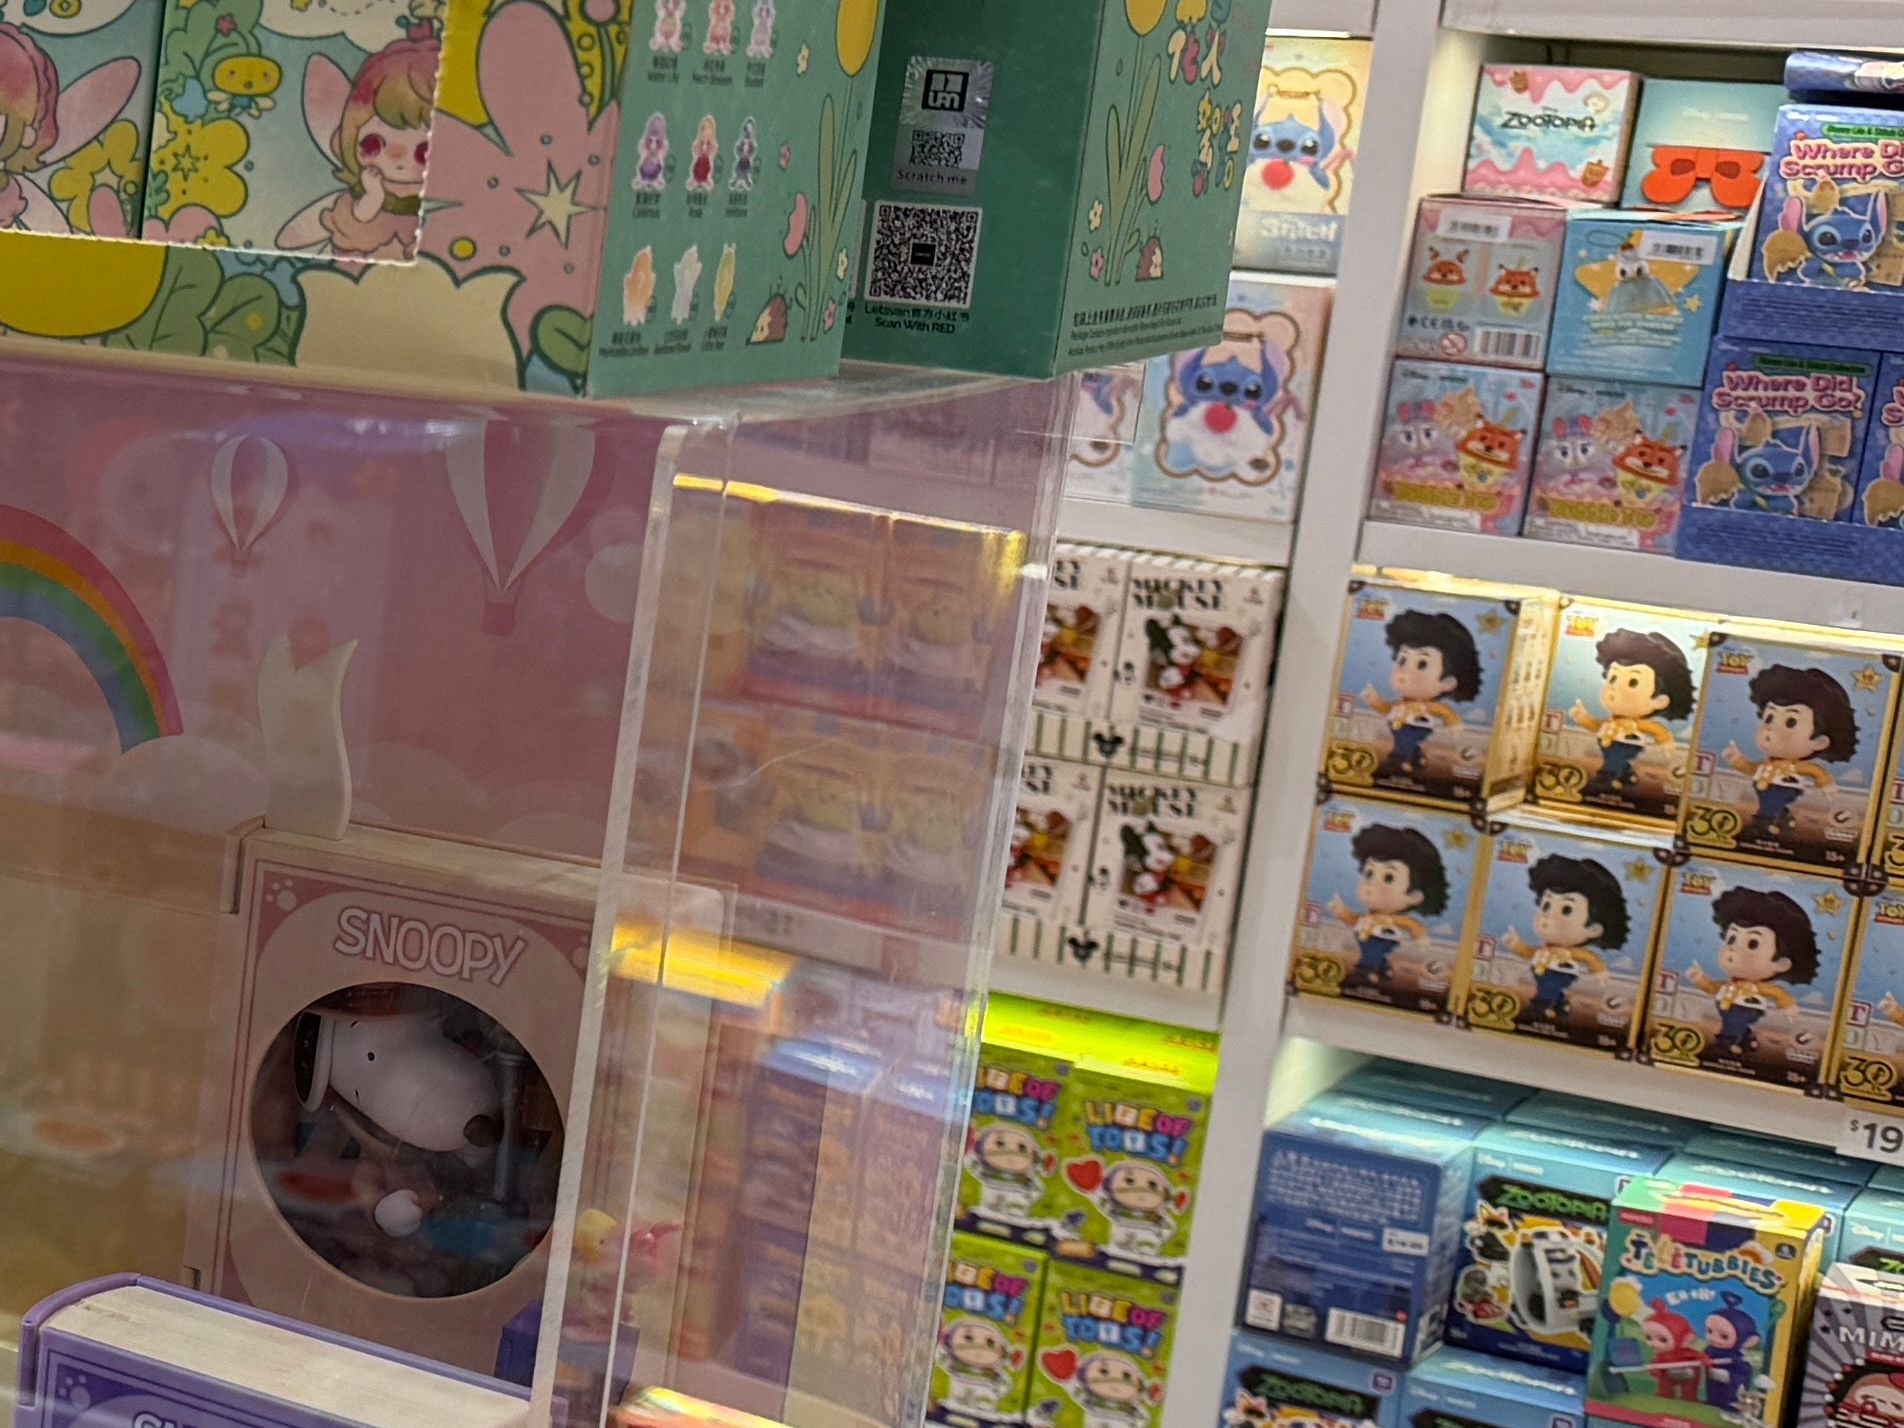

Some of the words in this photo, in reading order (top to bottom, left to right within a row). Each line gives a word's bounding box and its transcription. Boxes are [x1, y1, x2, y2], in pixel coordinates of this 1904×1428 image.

[896, 168, 941, 185] Scratch
[943, 173, 968, 186] me
[875, 319, 901, 332] Scan
[902, 321, 930, 333] With
[930, 323, 956, 334] RED
[1723, 374, 1796, 393] Where
[1808, 375, 1853, 390] Did
[1717, 391, 1806, 411] Scrump
[333, 905, 528, 986] SNOOPY
